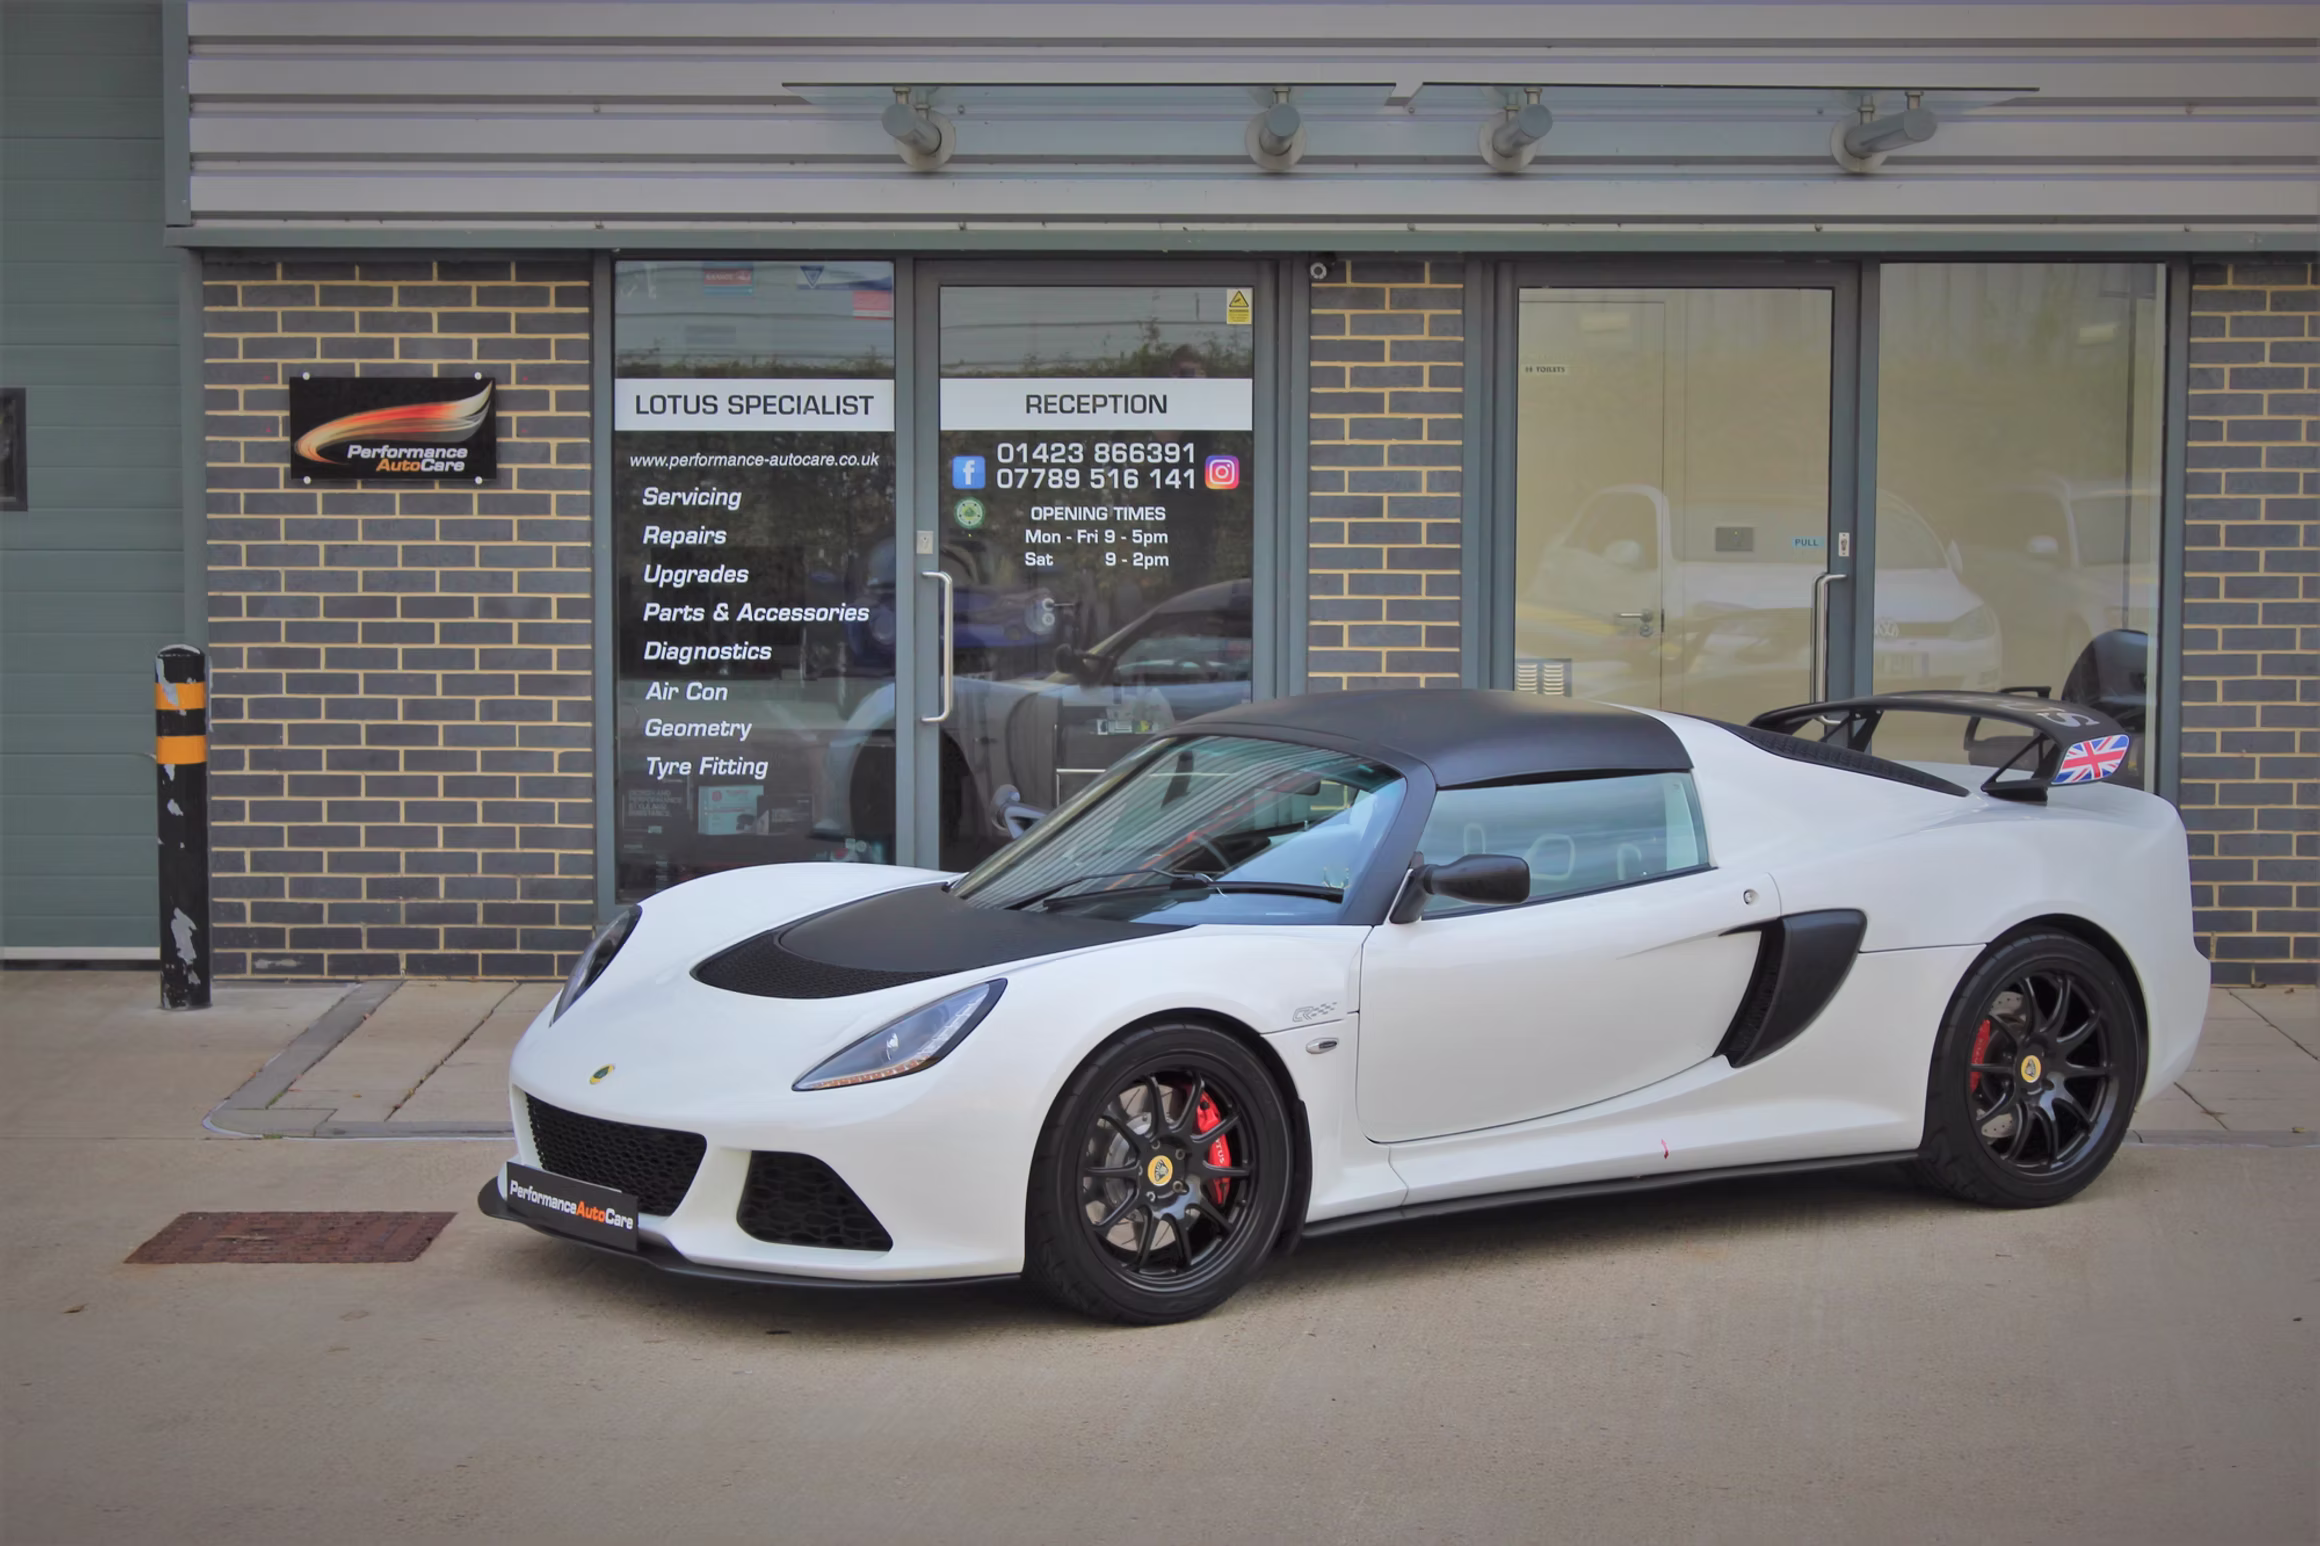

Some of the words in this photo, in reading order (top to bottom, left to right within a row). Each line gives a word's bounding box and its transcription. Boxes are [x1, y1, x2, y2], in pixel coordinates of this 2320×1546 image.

[635, 394, 719, 416] LOTUS
[727, 394, 875, 416] SPECIALIST
[1025, 394, 1168, 415] RECEPTION
[346, 444, 468, 460] Performance
[629, 450, 880, 471] www.performance-autocare.co.uk
[997, 442, 1084, 464] 01423
[1094, 442, 1195, 464] 866391
[375, 458, 466, 473] AutoCare
[996, 468, 1080, 490] 07789
[1090, 468, 1139, 490] 516
[1149, 468, 1195, 490] 141
[642, 486, 743, 511] Servicing
[1030, 506, 1108, 521] OPENING
[1112, 506, 1166, 521] TIMES
[642, 526, 728, 549] Repairs
[1025, 529, 1062, 544] Mon
[1077, 529, 1099, 544] Fri
[1104, 529, 1116, 544] 9
[1131, 529, 1169, 548] 5pm
[1794, 538, 1819, 547] PULL
[1024, 552, 1054, 567] Sat
[1105, 552, 1117, 567] 9
[1132, 552, 1169, 570] 2pm
[643, 564, 750, 588] Upgrades
[643, 603, 706, 622] Parts
[712, 602, 730, 622] &
[736, 602, 870, 622] Accessories
[643, 641, 773, 665] Diagnostics
[645, 681, 680, 701] Air
[685, 681, 729, 701] Con
[644, 718, 753, 742] Geometry
[646, 757, 692, 781] Tyre
[699, 756, 769, 781] Fitting
[509, 1179, 635, 1230] PerformanceAutoCare
